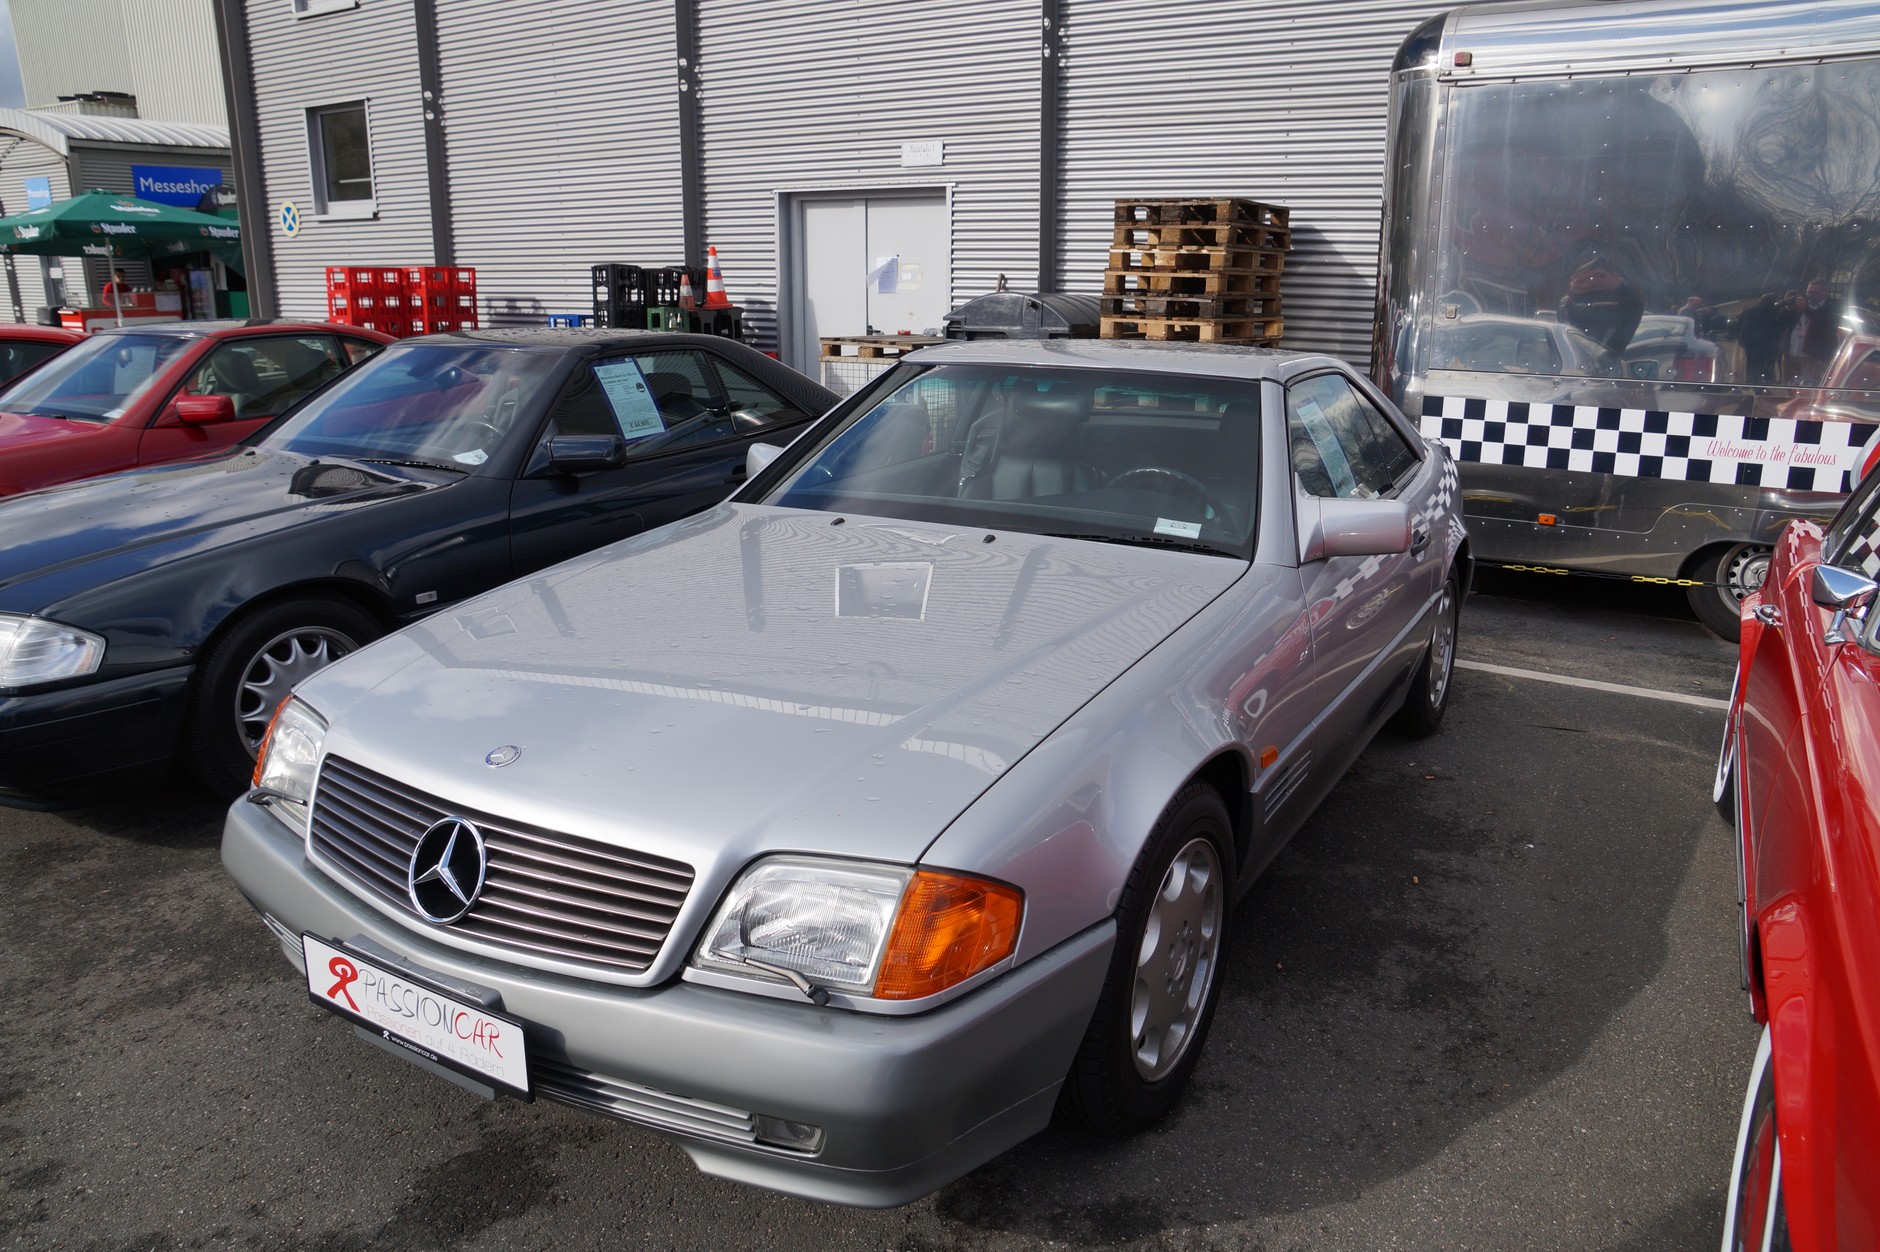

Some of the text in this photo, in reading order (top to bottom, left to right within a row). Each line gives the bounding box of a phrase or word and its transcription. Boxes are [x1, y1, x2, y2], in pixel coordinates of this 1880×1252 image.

[100, 222, 137, 235] Stauder
[208, 226, 240, 239] Stauder
[1706, 440, 1838, 466] Welcome to the fabulous
[358, 968, 504, 1059] PASSIONCAR
